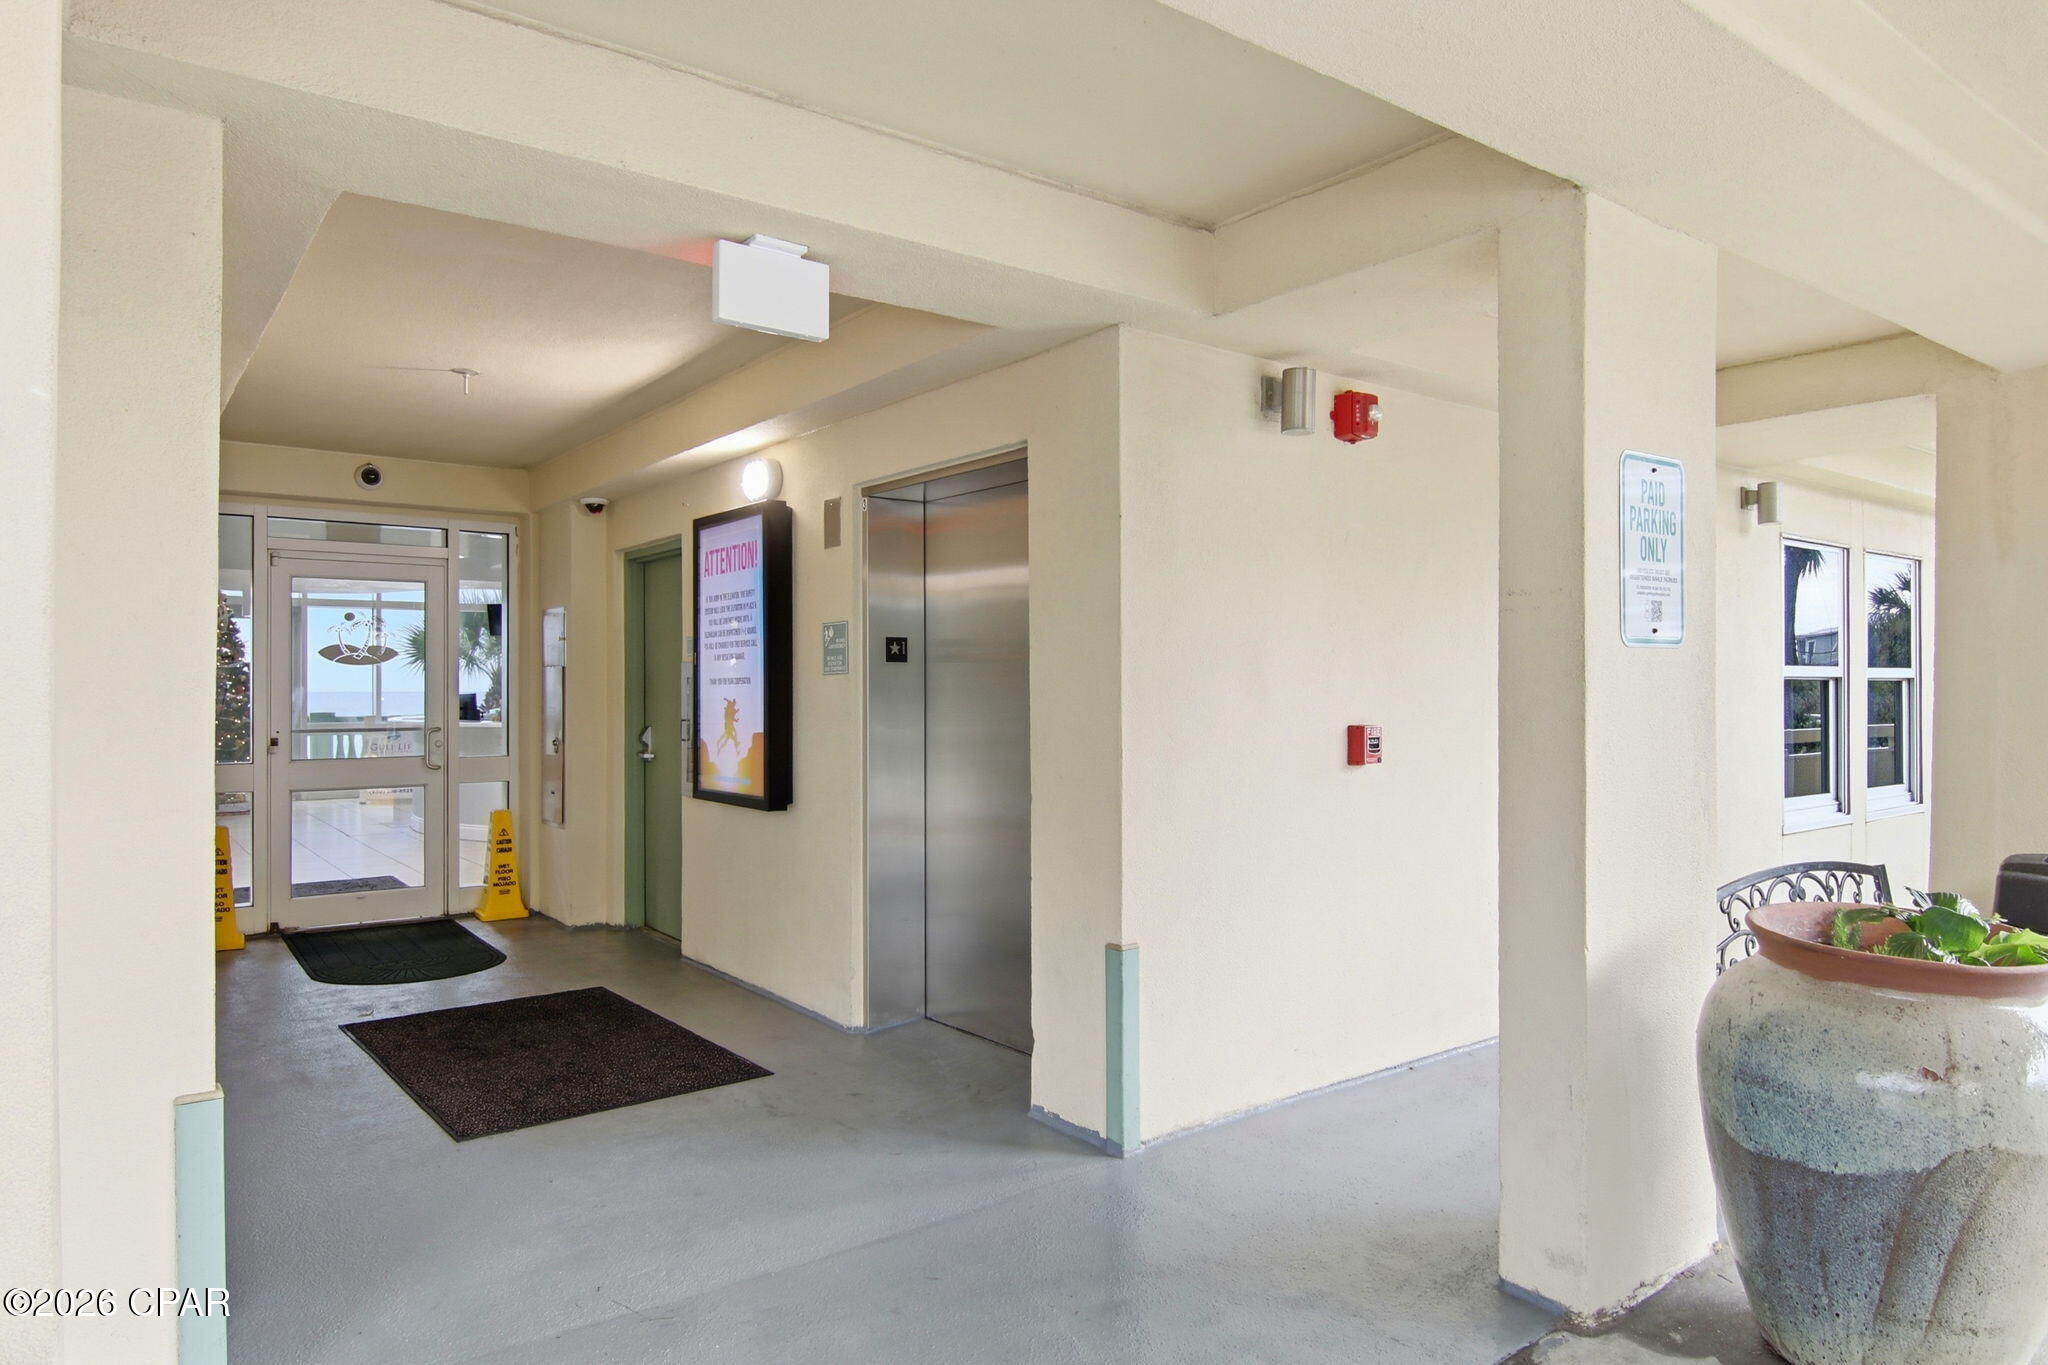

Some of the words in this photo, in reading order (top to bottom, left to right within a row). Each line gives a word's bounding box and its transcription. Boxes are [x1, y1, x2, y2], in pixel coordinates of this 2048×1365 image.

[1641, 478, 1666, 507] PAID
[1629, 504, 1677, 536] PARKING
[703, 539, 758, 578] ATTENTION!
[1640, 535, 1668, 563] ONLY
